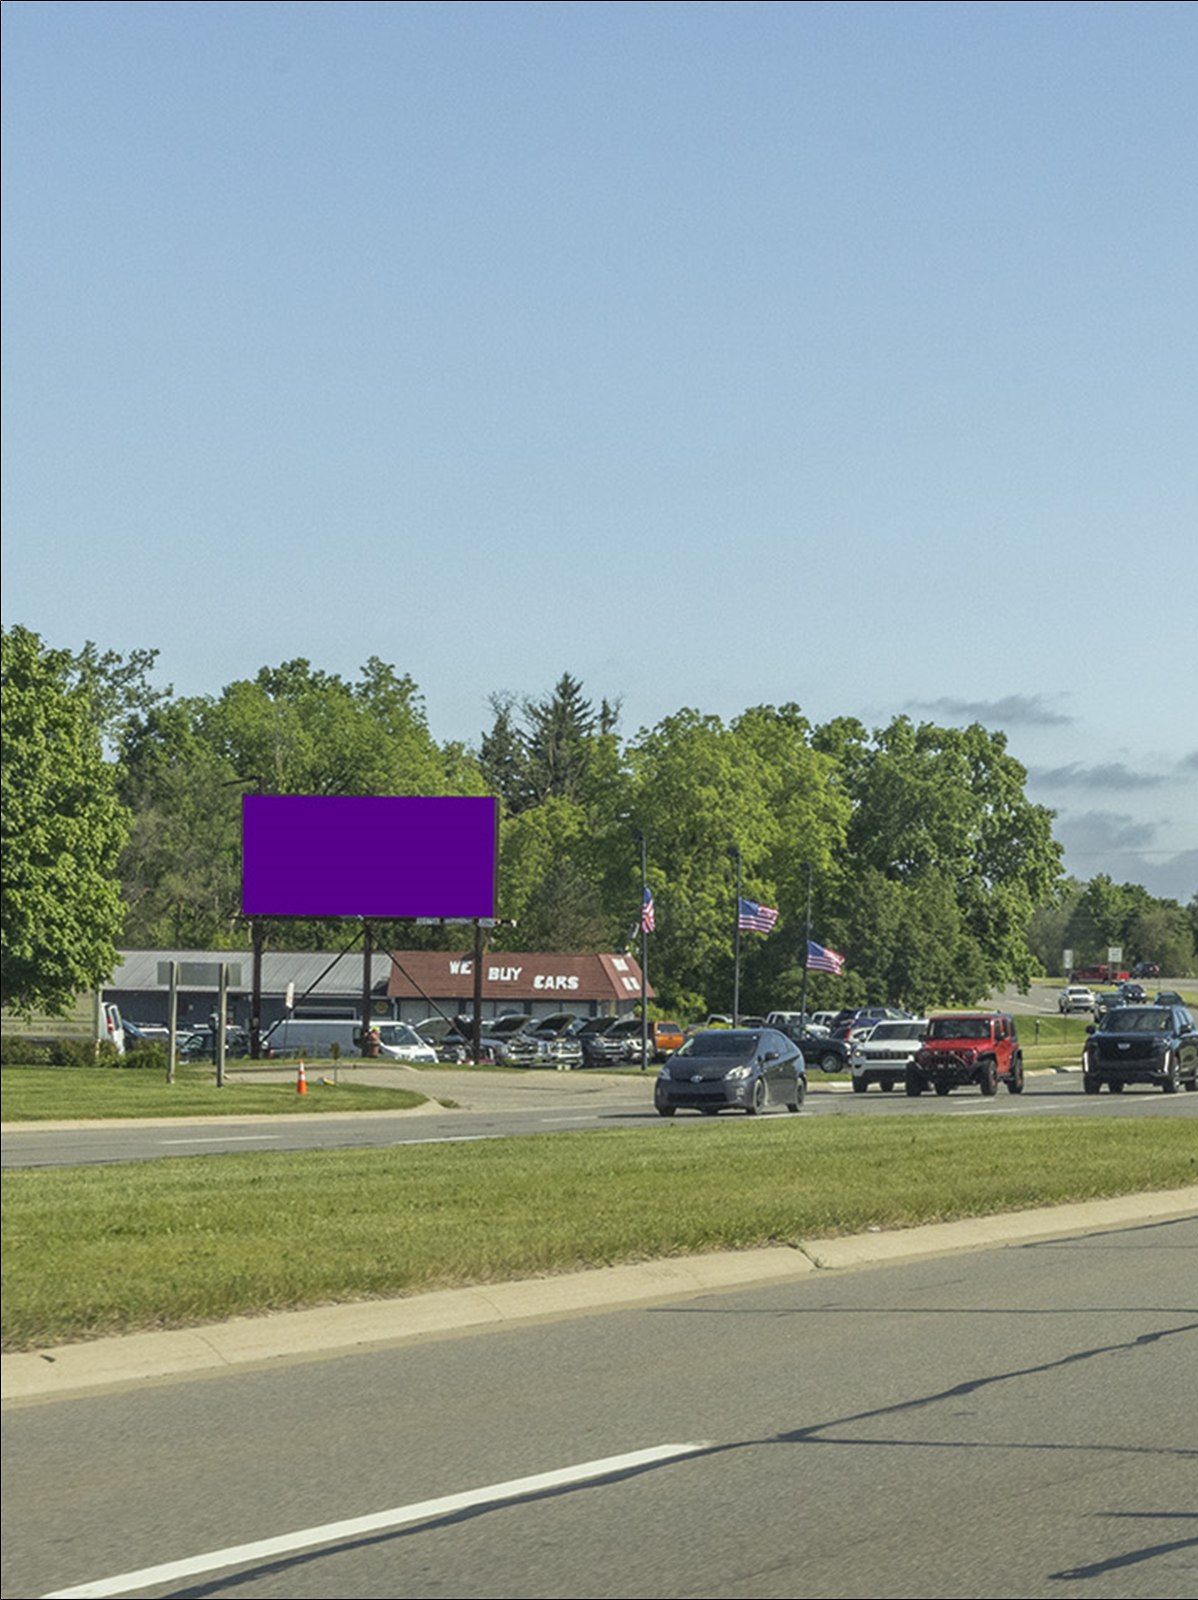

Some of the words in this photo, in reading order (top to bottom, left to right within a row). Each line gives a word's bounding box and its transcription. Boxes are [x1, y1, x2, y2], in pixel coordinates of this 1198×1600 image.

[449, 961, 472, 974] WE
[488, 967, 522, 981] BUY
[533, 975, 579, 990] CARS
